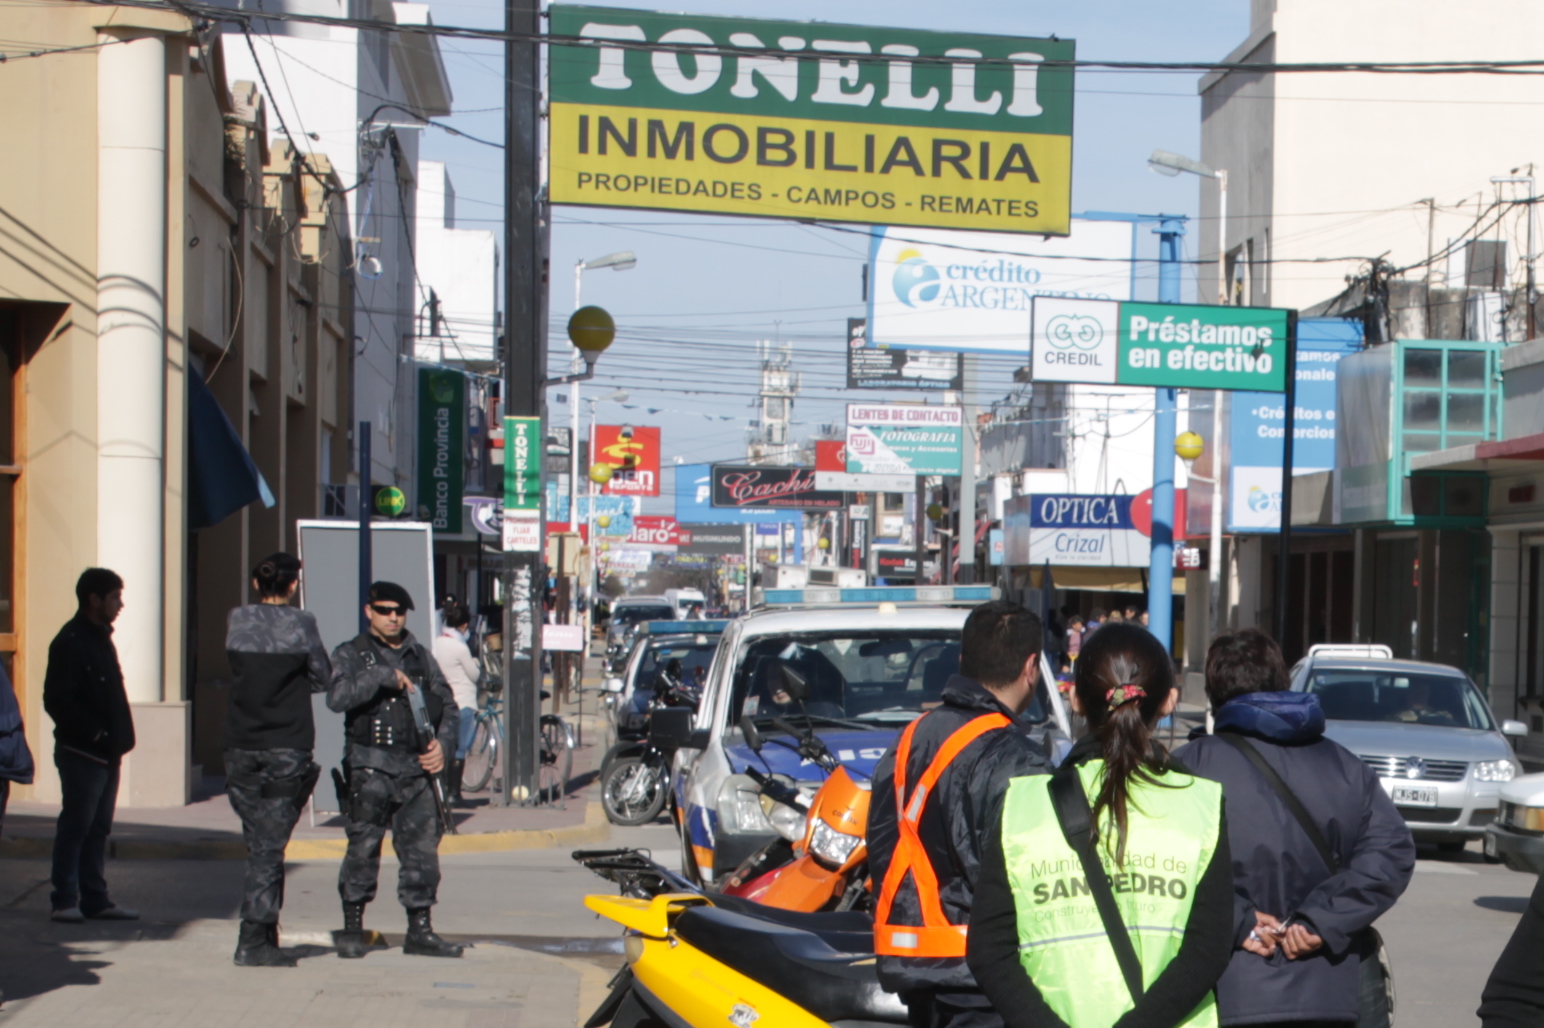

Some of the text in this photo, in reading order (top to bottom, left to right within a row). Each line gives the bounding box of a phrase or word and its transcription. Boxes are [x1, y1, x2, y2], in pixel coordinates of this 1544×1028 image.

[580, 22, 1044, 116] TONELLI
[578, 114, 1041, 183] INMOBILIARIA
[577, 172, 762, 201] PROPIEDADES
[786, 186, 896, 210] CAMPOS
[920, 194, 1039, 218] REMATES
[946, 258, 1041, 285] crédito
[940, 284, 1112, 311] ARGEN
[1129, 314, 1273, 348] Préstamos
[1044, 351, 1103, 366] CREDIL
[1128, 344, 1272, 374] en efectivo
[852, 408, 959, 423] LENTES DE CONTACTO
[1258, 405, 1323, 421] Créitos
[433, 407, 449, 529] Banco Provincia
[514, 423, 528, 505] TONELLI
[1040, 496, 1120, 524] OPTICA
[506, 536, 538, 545] CARTELES
[513, 526, 531, 535] FIJAR
[1055, 532, 1106, 554] Crizal
[1163, 855, 1187, 874] de
[1033, 876, 1092, 905] SAN
